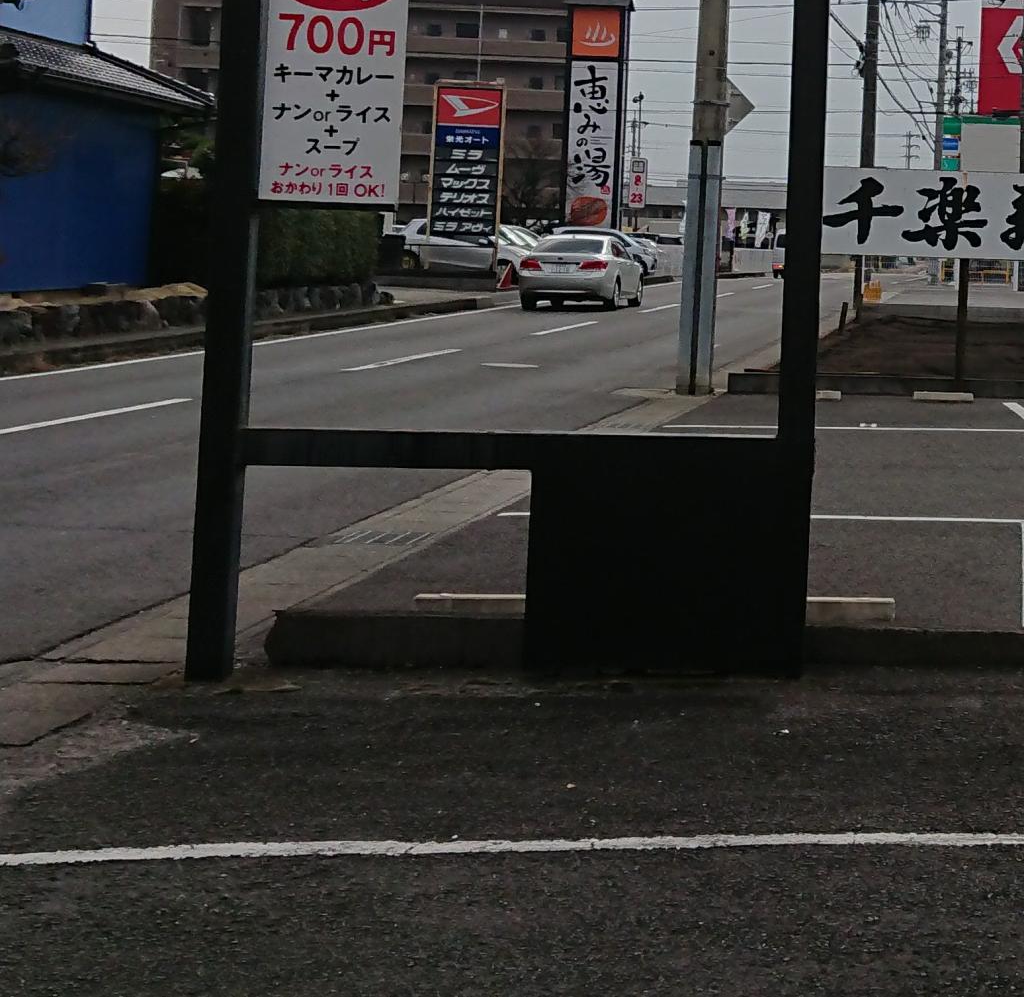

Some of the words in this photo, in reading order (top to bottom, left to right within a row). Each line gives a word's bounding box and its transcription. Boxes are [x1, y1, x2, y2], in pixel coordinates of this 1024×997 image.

[279, 13, 396, 56] 700円
[273, 63, 394, 86] キーマカレー
[573, 65, 611, 187] 恵みの湯
[305, 137, 360, 156] スープ
[450, 149, 484, 160] ミラ
[446, 163, 486, 175] ムーヴ
[440, 177, 490, 190] マックス
[439, 192, 490, 204] テリオス
